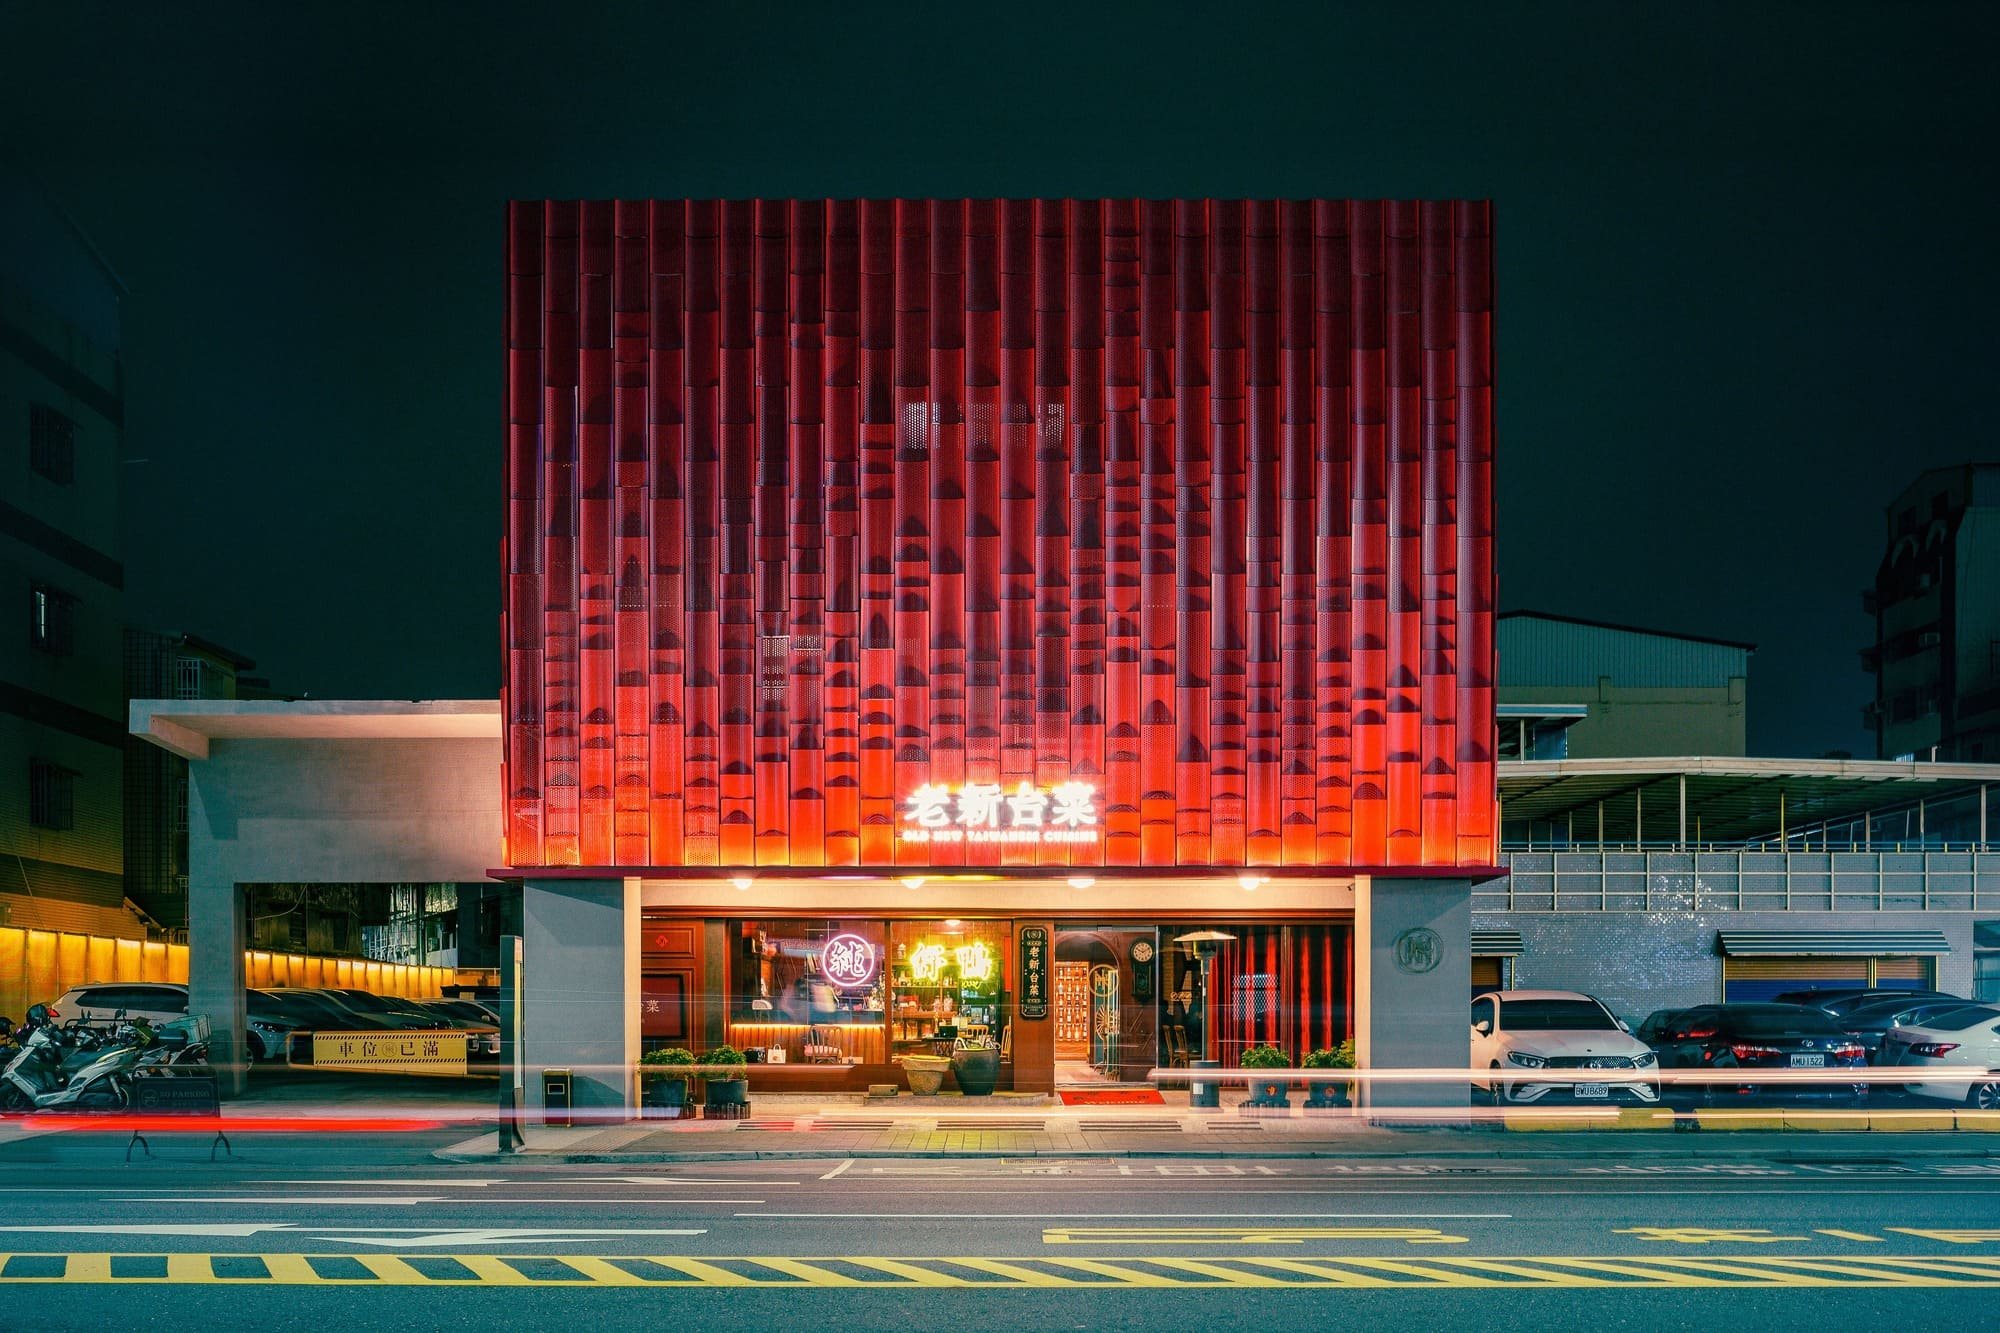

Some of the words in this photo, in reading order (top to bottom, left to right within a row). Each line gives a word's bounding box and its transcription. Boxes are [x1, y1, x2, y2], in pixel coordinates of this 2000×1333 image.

[904, 782, 1097, 827] 老新台菜
[1029, 946, 1040, 997] 老新台菜
[339, 1041, 439, 1057] 車位已滿
